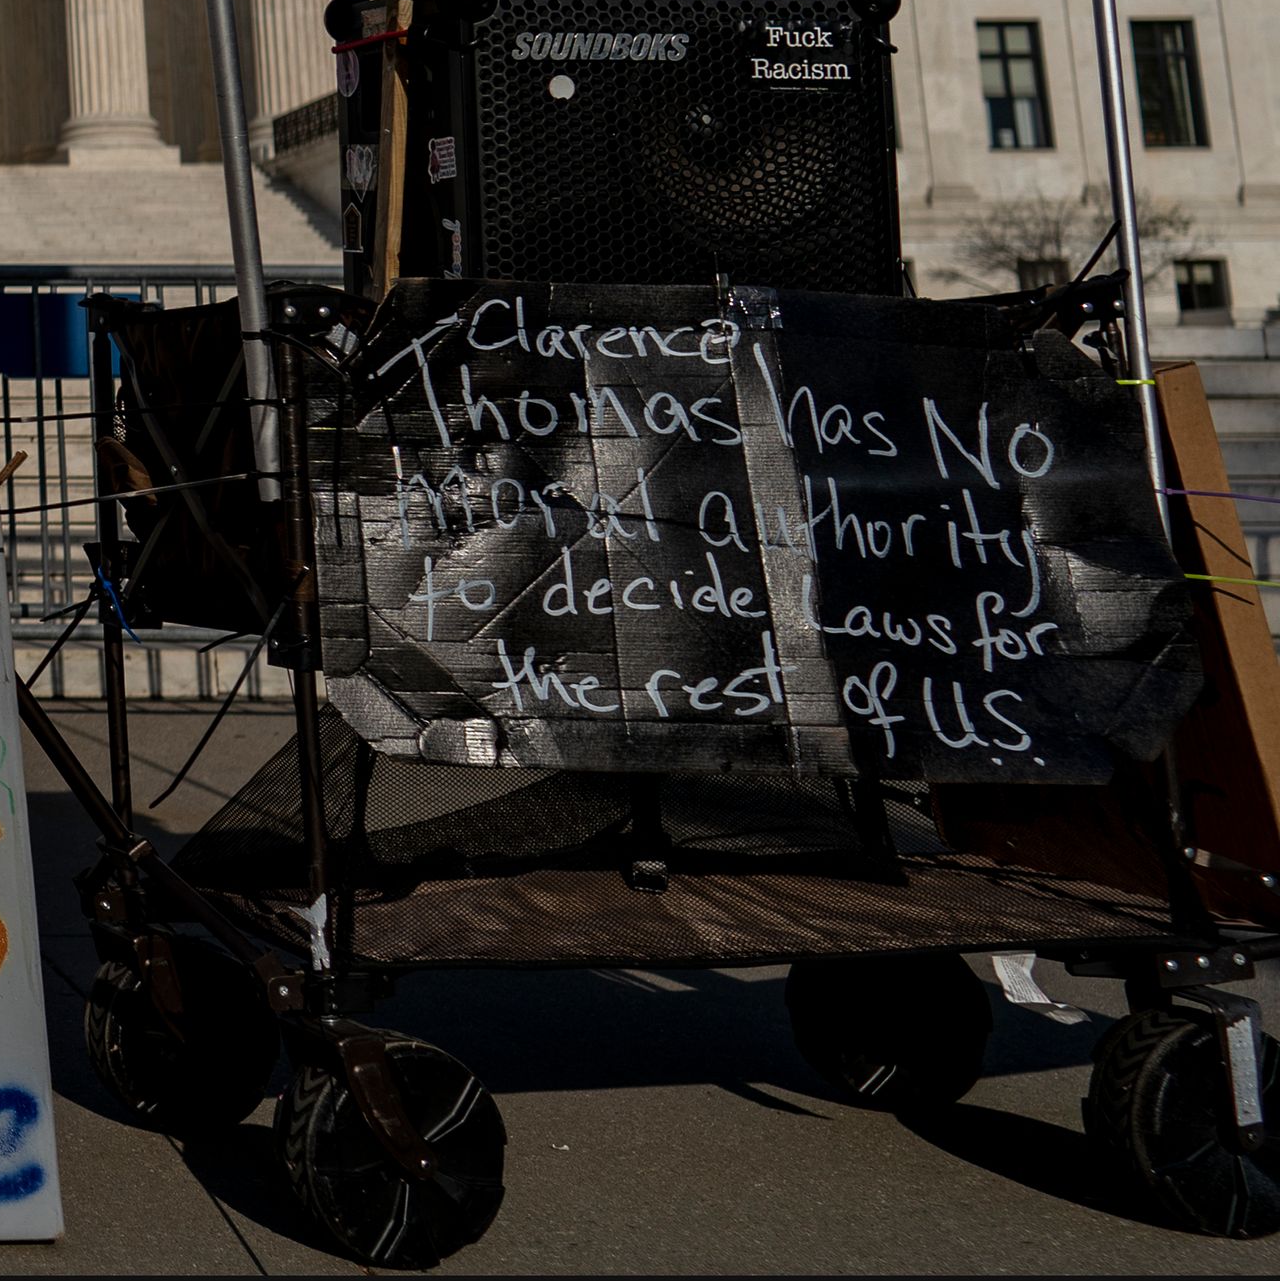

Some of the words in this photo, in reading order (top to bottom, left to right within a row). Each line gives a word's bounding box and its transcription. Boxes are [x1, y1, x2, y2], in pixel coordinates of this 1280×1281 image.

[511, 32, 690, 62] SOUNDBOKS
[750, 58, 852, 80] Racism
[765, 26, 834, 48] Fuck
[367, 312, 743, 448] Thomas
[753, 342, 897, 457] has
[408, 556, 496, 642] to
[542, 546, 768, 618] decide
[971, 591, 1059, 672] for
[698, 474, 1041, 618] authority
[492, 638, 620, 712] the
[644, 630, 798, 717] rest
[843, 661, 905, 758] of
